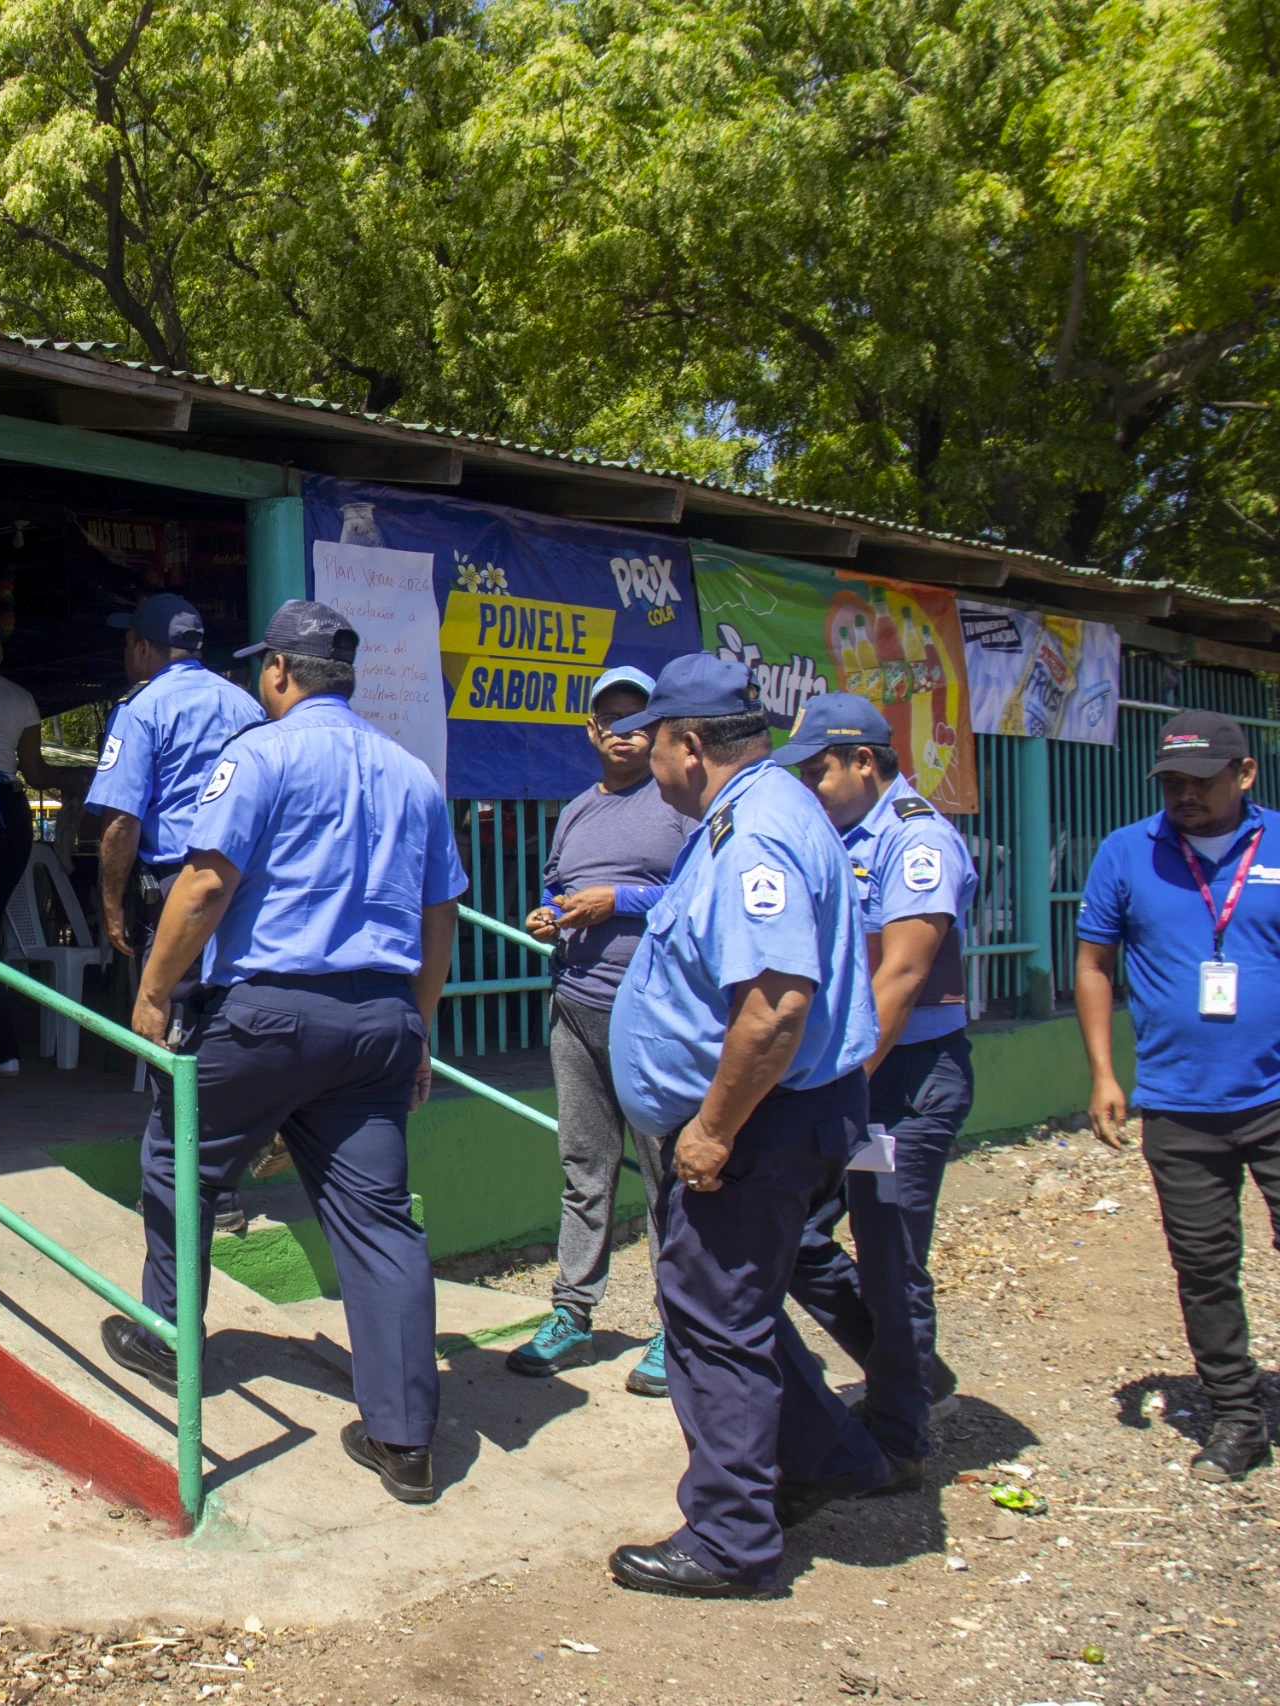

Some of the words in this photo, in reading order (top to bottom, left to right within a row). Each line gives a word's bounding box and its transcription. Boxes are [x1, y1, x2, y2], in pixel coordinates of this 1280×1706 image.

[322, 553, 355, 583] Plan
[477, 602, 587, 655] PONELE
[647, 604, 676, 627] COLA
[964, 621, 975, 635] TU
[981, 634, 991, 644] ES
[469, 666, 558, 713] SABOR
[565, 674, 600, 715] NI
